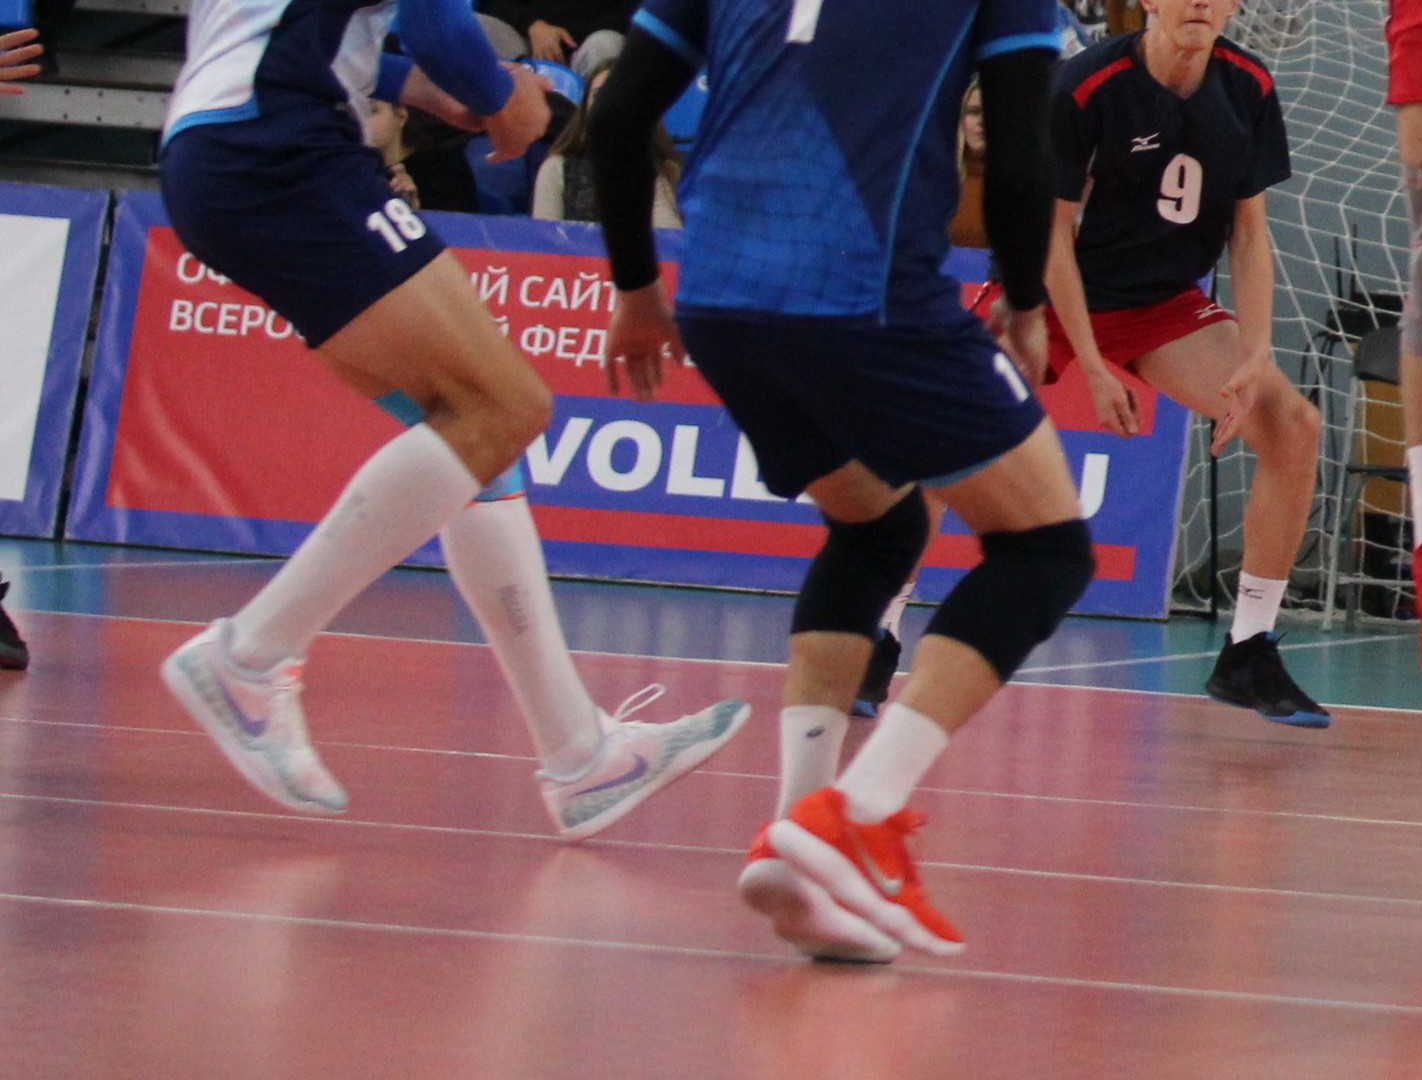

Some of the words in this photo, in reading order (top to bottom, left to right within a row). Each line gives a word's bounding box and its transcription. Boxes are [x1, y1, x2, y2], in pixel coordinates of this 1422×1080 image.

[1157, 153, 1203, 224] 9
[366, 198, 426, 253] 18
[519, 272, 617, 312] САЙТ
[169, 299, 306, 341] ВСЕРО
[520, 324, 626, 368] ФЕД
